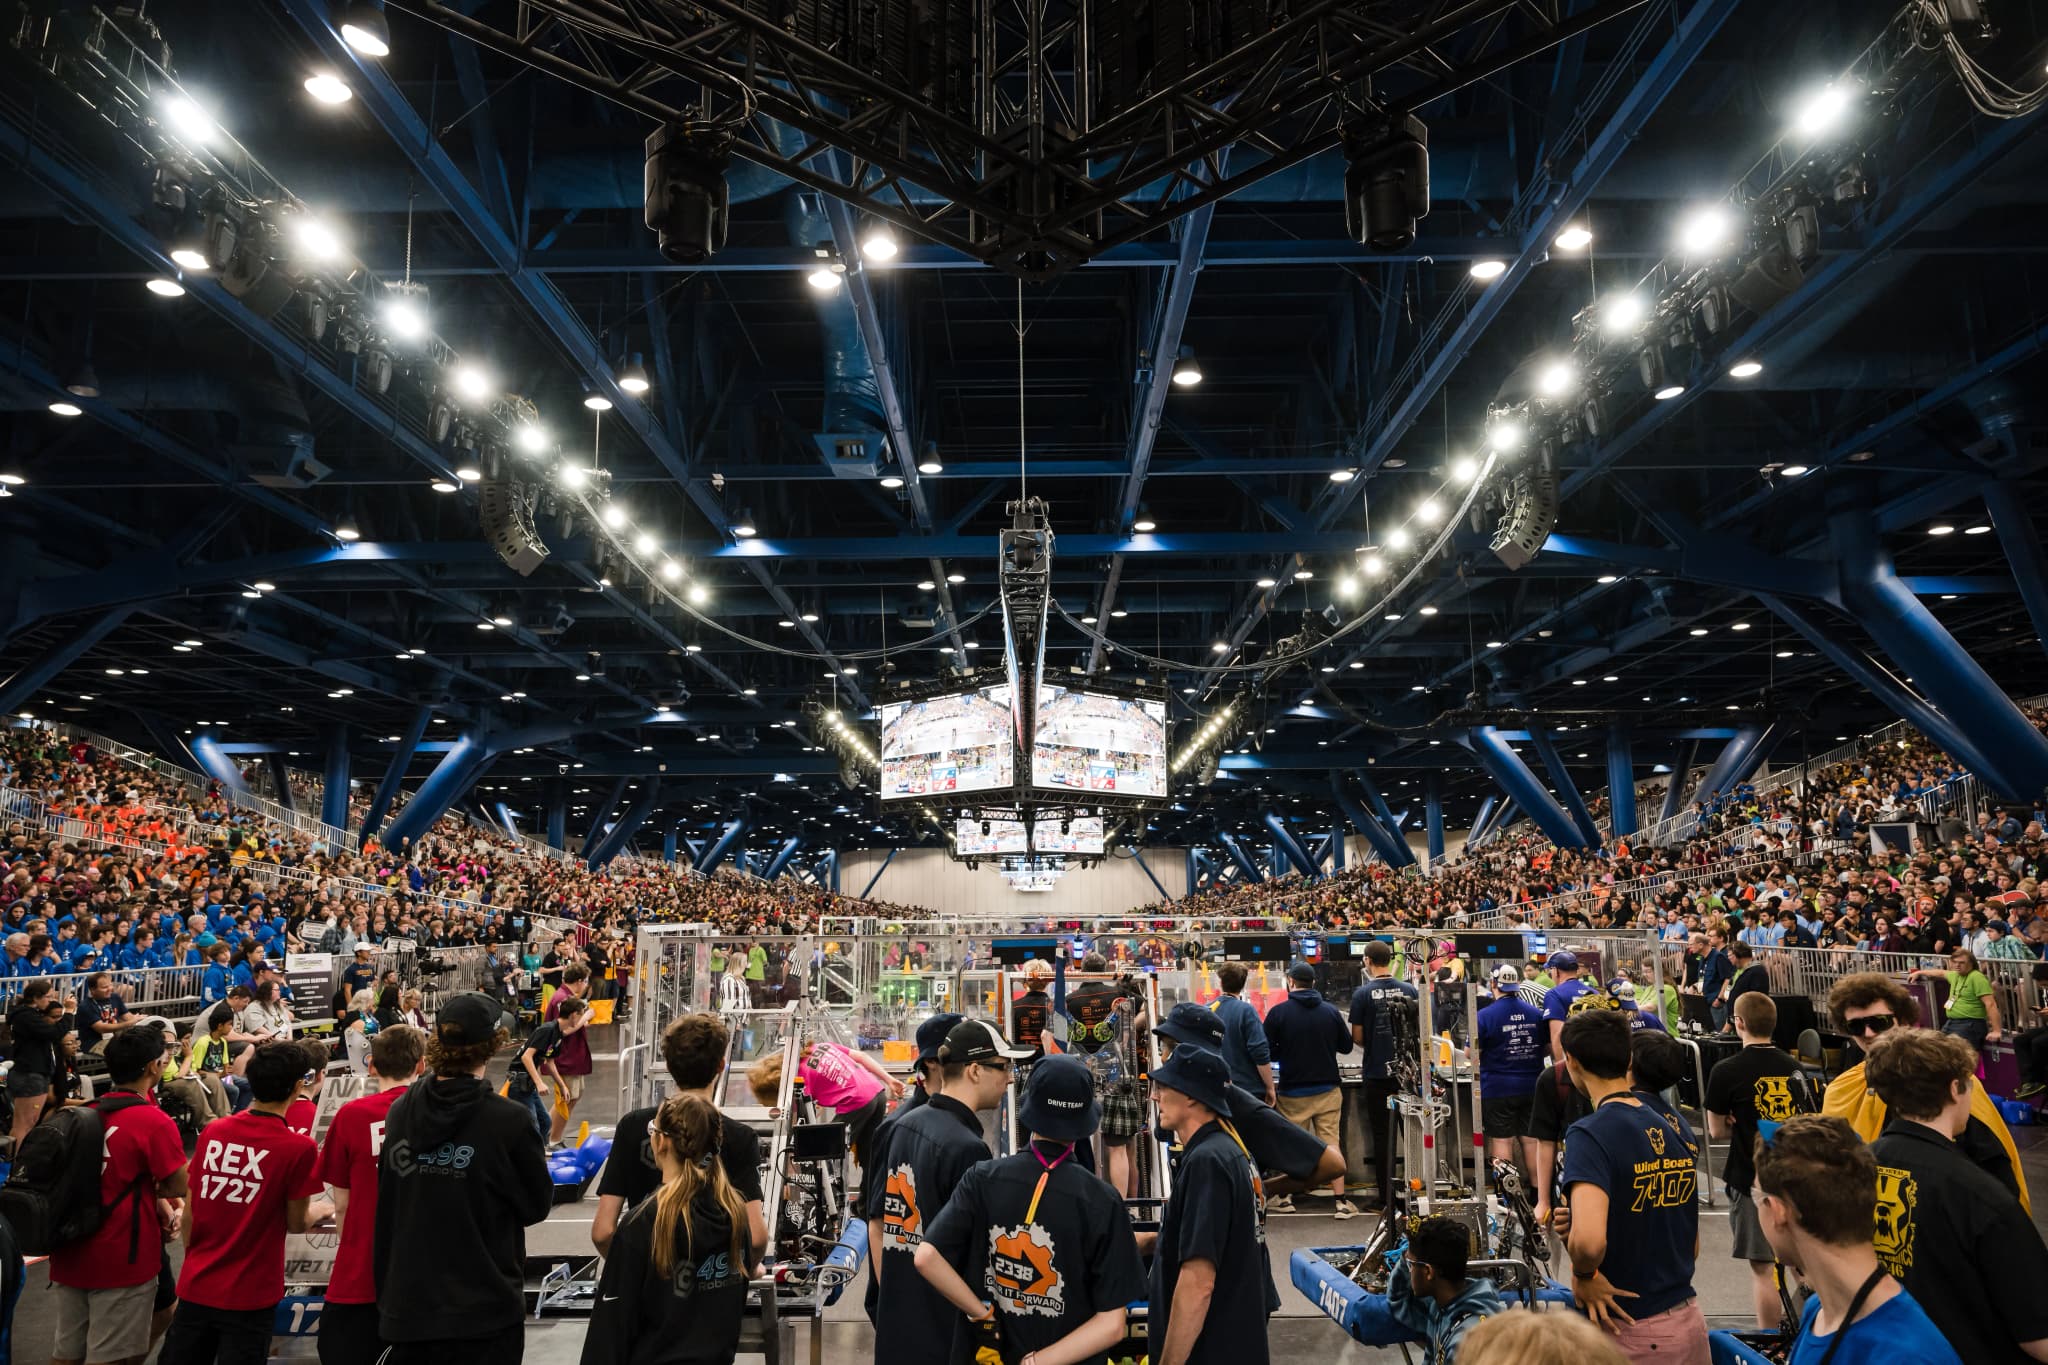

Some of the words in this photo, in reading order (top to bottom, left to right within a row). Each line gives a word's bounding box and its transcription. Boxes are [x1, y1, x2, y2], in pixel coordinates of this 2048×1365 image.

[1047, 1098, 1067, 1108] DRIVE
[1067, 1101, 1084, 1109] TEAM
[202, 1139, 270, 1180] REX
[1662, 1158, 1694, 1169] Boars
[200, 1174, 261, 1205] 1727
[1631, 1168, 1697, 1212] 7407
[995, 1256, 1034, 1281] 2338
[1004, 1289, 1013, 1297] IT
[1318, 1279, 1349, 1325] 7407
